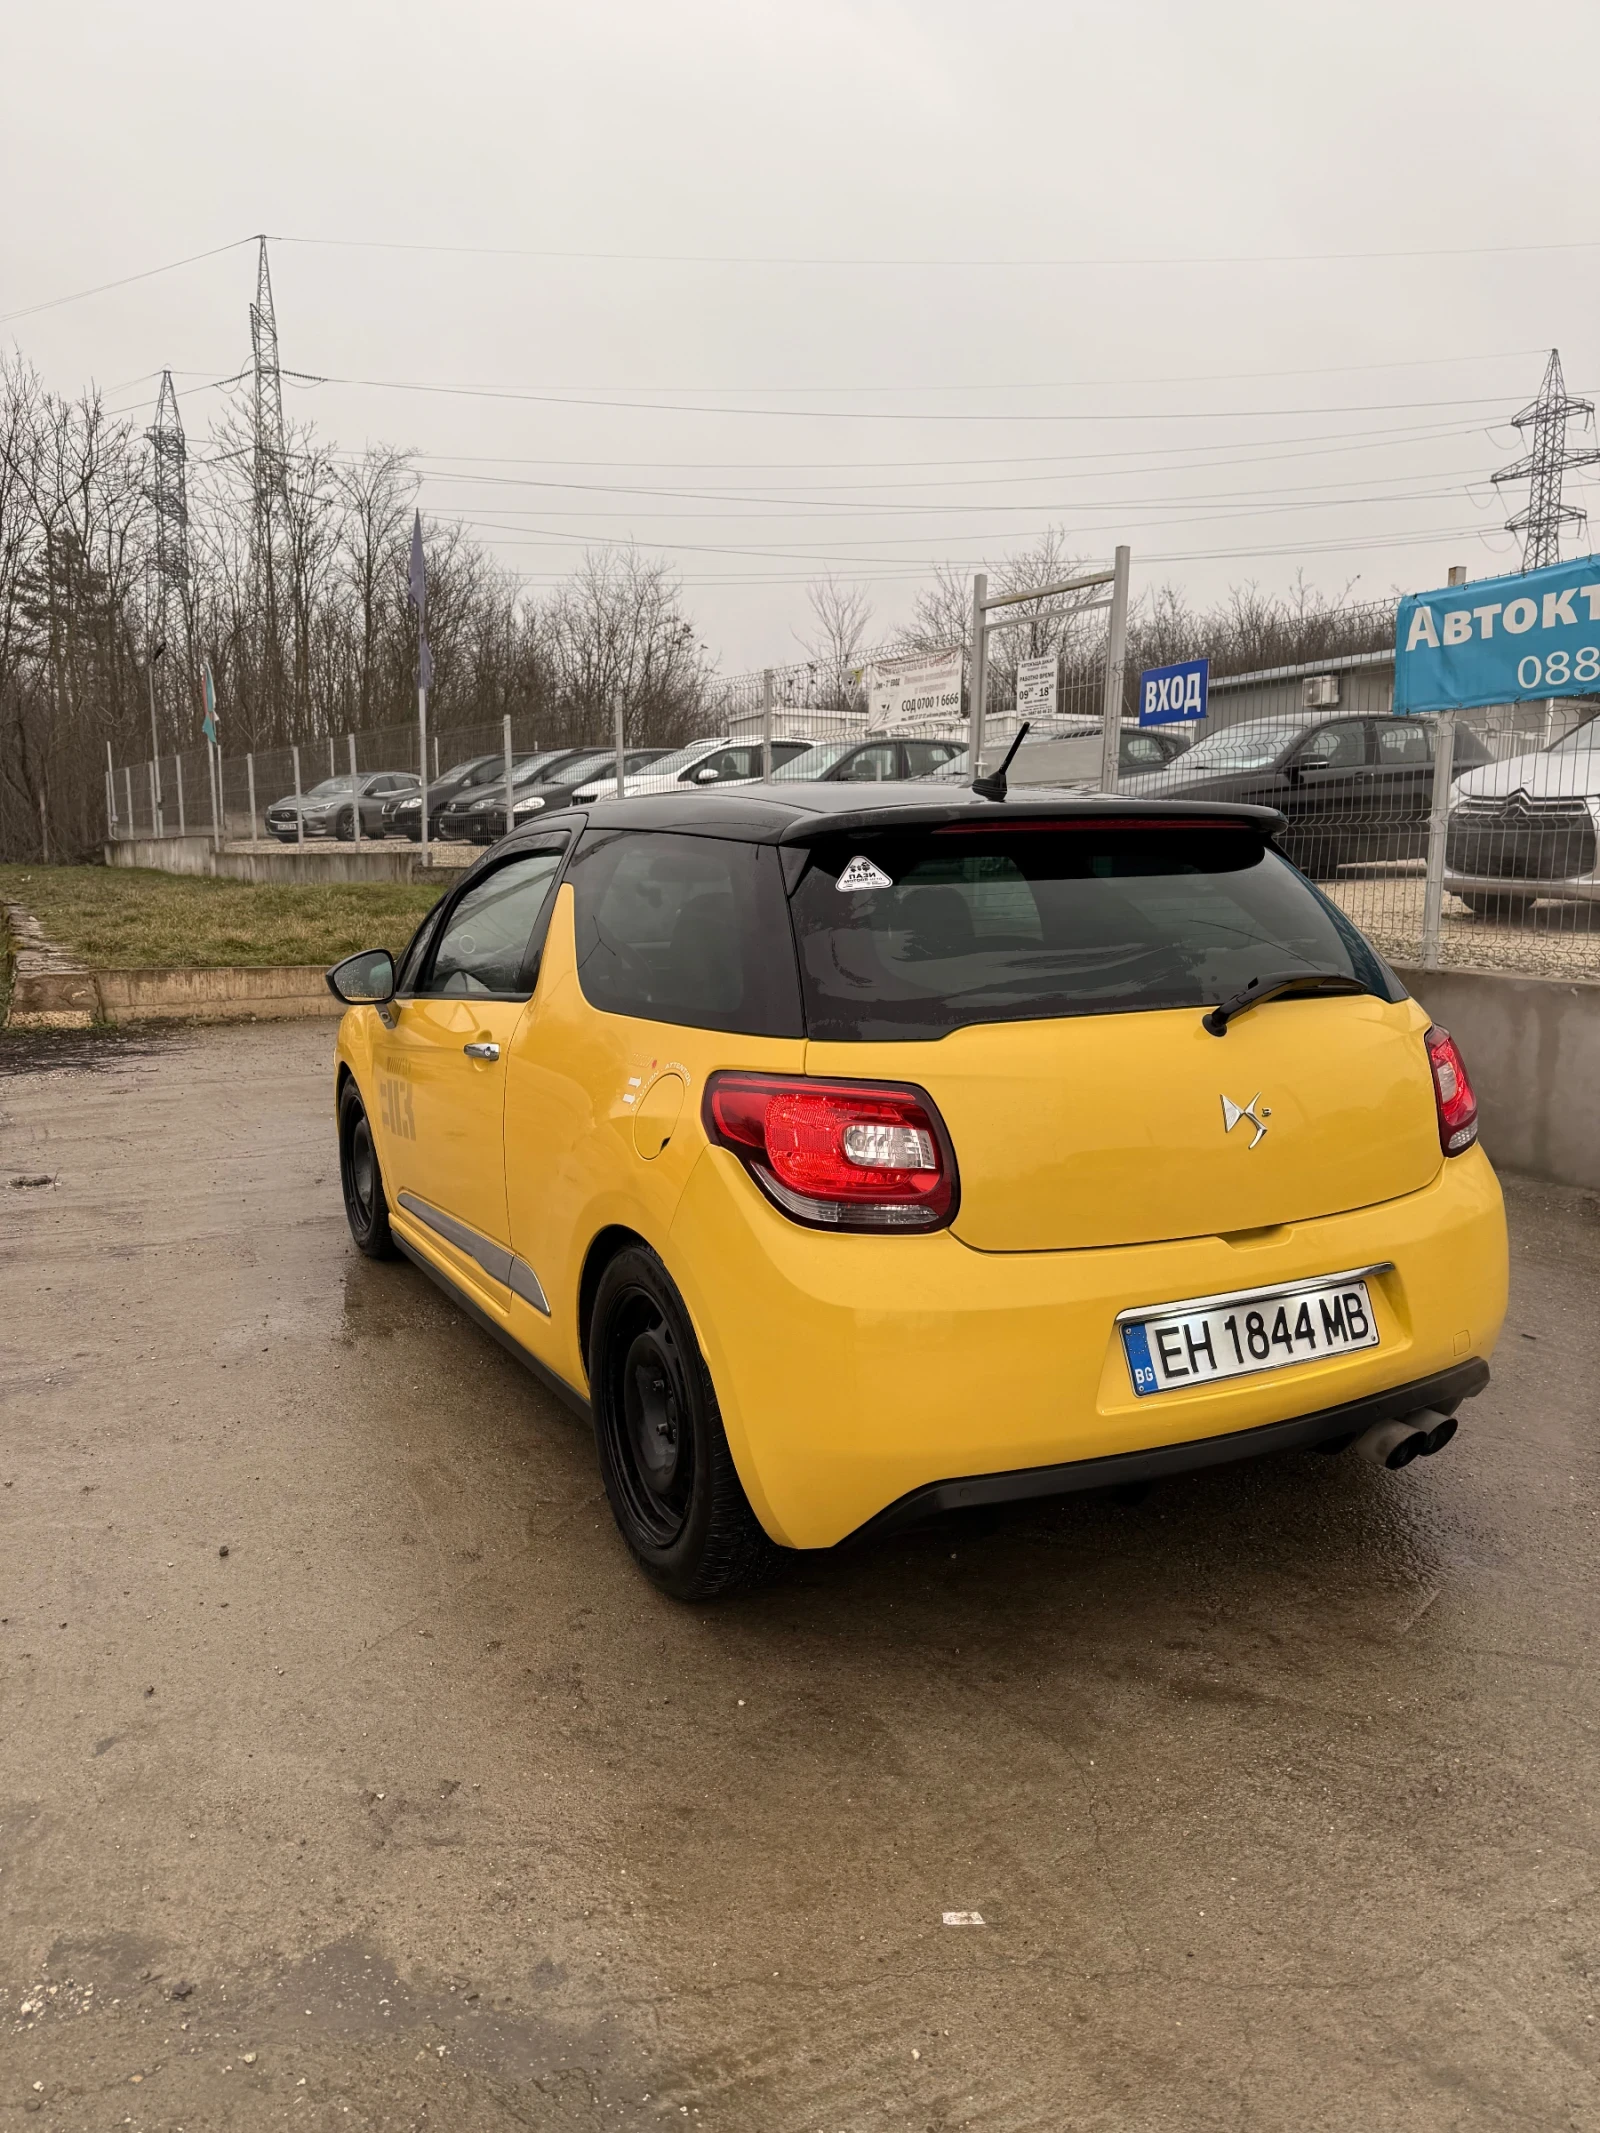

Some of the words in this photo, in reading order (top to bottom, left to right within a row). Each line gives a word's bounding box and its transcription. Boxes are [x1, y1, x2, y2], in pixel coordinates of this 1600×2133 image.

[901, 699, 916, 713] СОД
[917, 696, 934, 710] 0700
[941, 692, 959, 706] 6666
[1145, 672, 1202, 715] ВХОД
[665, 1061, 692, 1087] ATTENTION
[1155, 1320, 1218, 1379] EH
[1224, 1301, 1316, 1364] 1844
[1319, 1292, 1369, 1347] MB
[1135, 1367, 1154, 1385] BG
